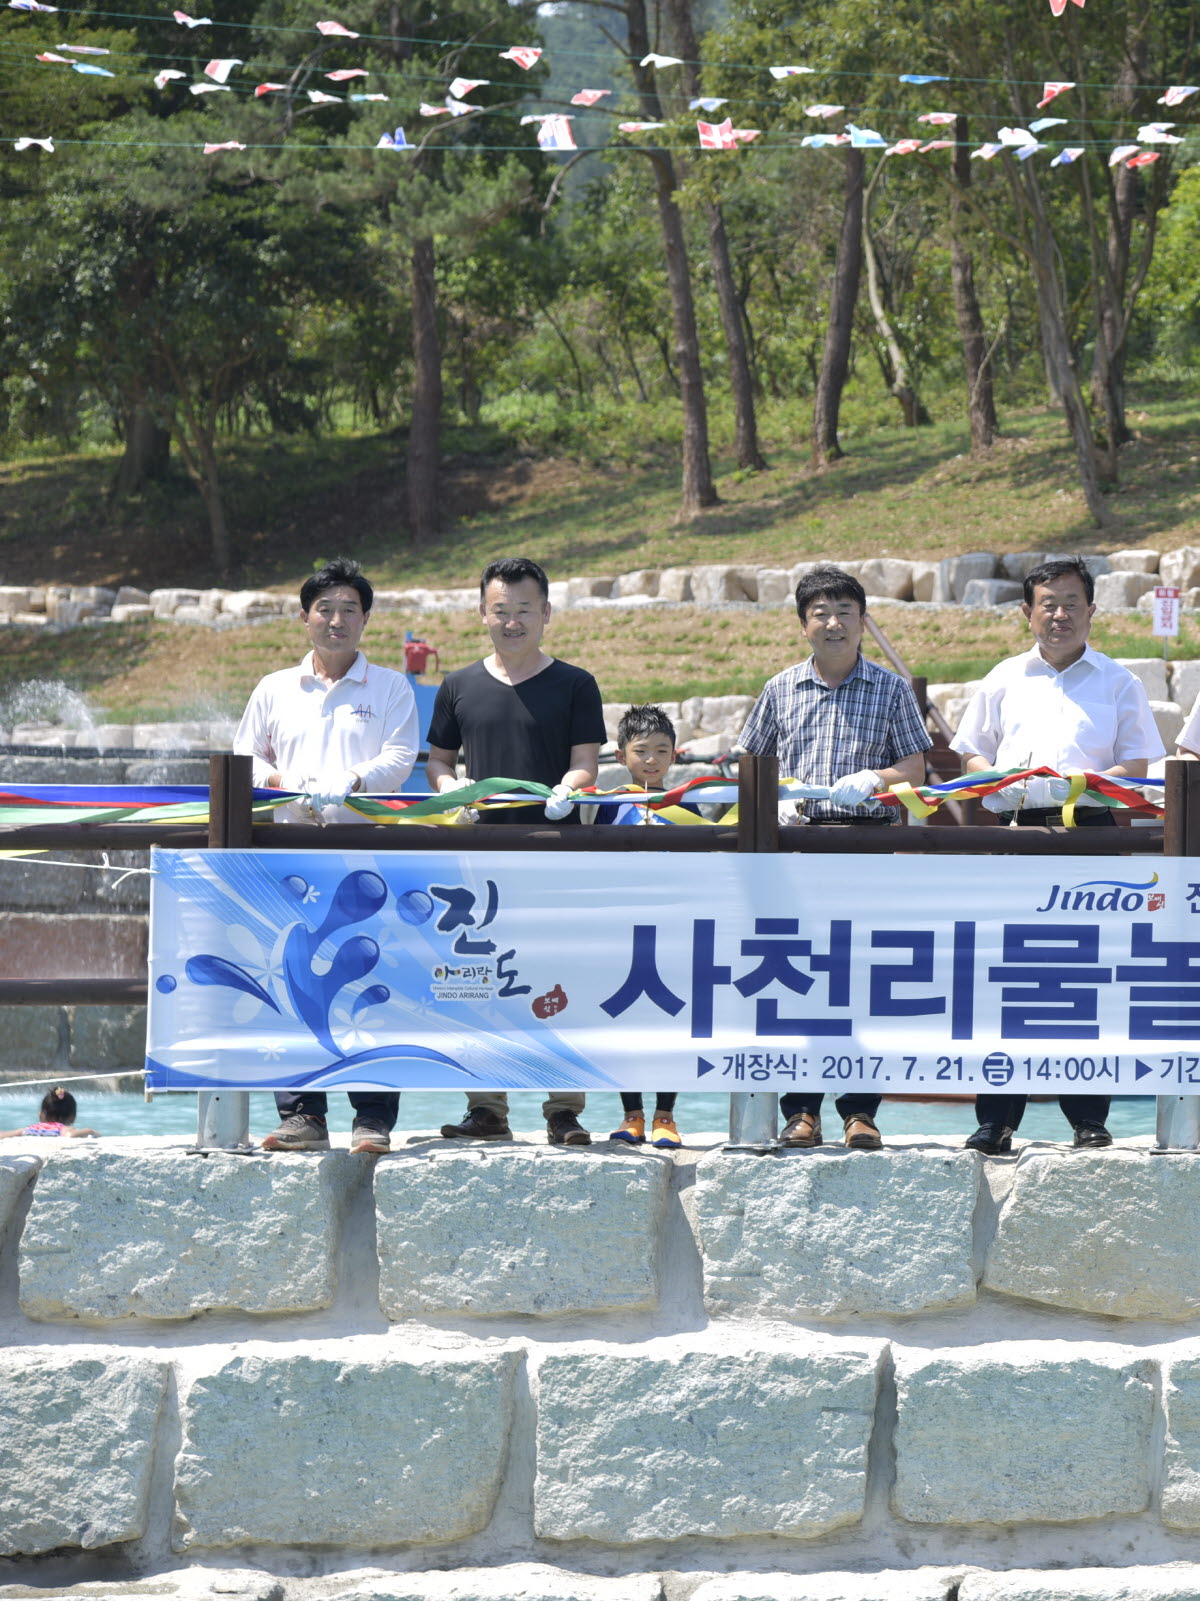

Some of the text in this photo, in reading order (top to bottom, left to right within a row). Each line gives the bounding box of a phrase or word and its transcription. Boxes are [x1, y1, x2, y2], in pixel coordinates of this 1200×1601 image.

[1036, 884, 1143, 912] Jindo
[434, 965, 493, 984] 아리랑
[721, 1052, 808, 1082] 개장식:
[821, 1055, 891, 1081] 2017.
[902, 1056, 925, 1081] 7.
[1022, 1056, 1120, 1083] 14:00시
